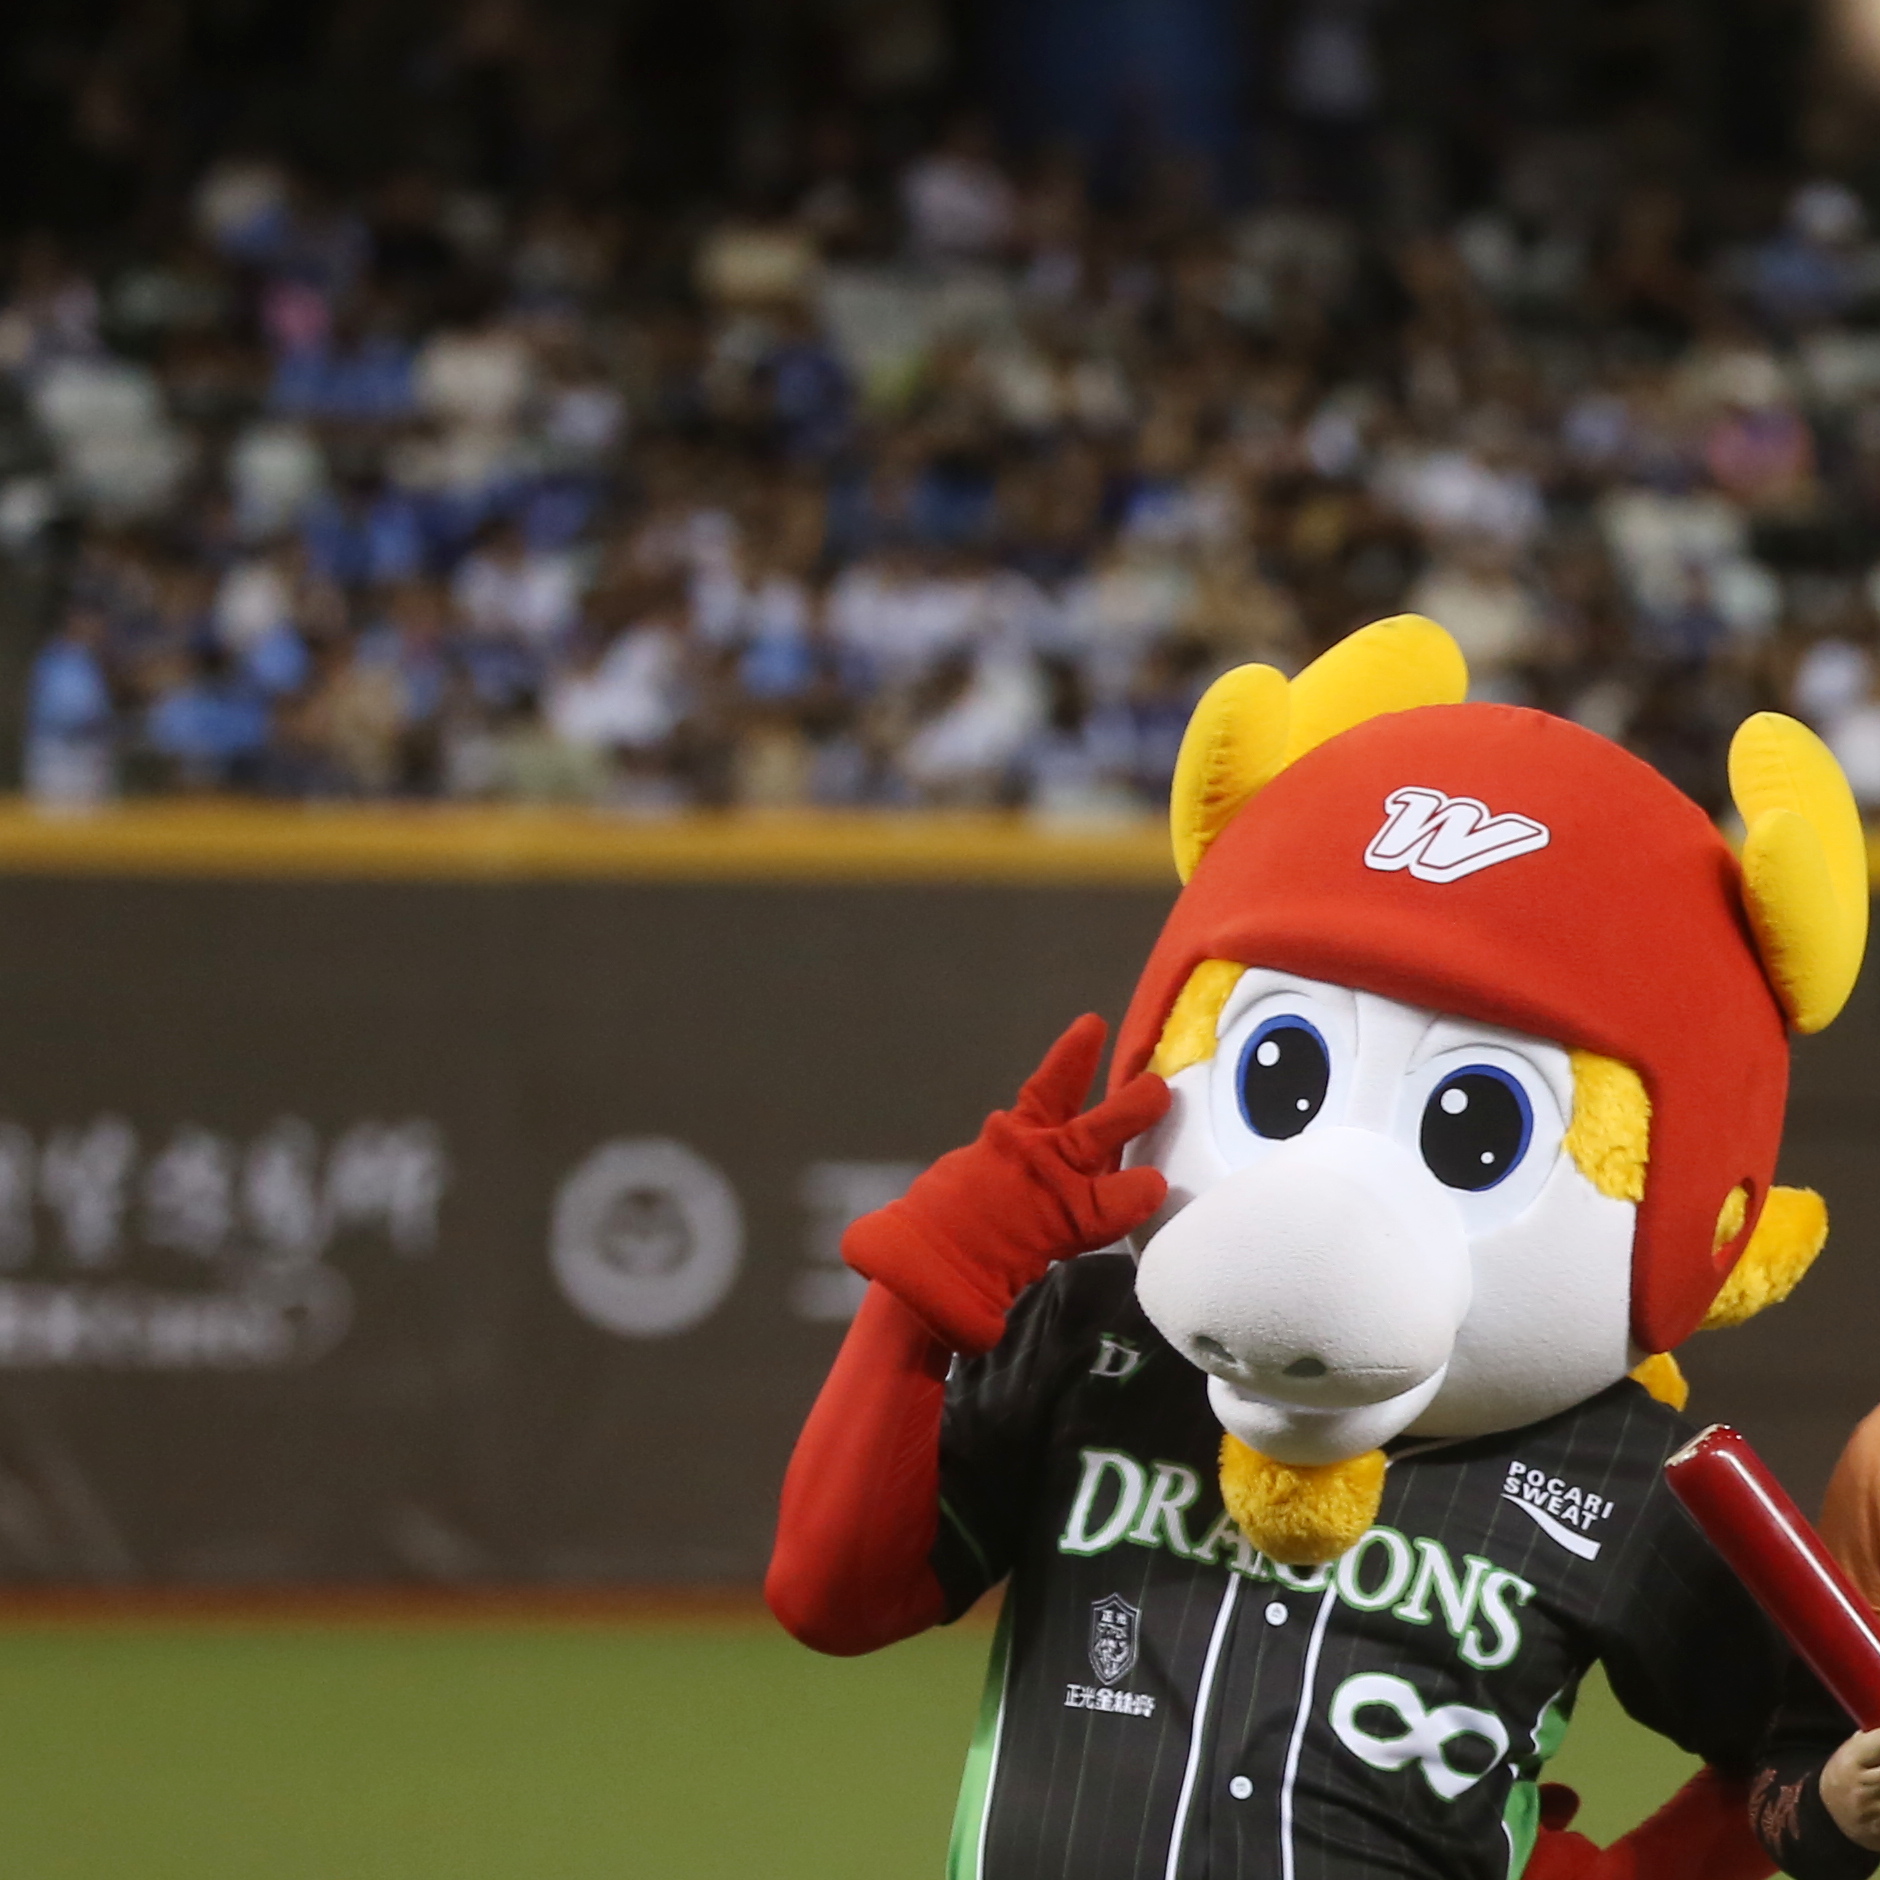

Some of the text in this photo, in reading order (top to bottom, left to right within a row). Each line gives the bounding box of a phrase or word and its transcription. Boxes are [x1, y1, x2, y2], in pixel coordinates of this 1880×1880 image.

[1364, 786, 1550, 884] W
[1503, 1476, 1599, 1531] SWEAT
[1508, 1460, 1615, 1519] POCARI
[1058, 1447, 1537, 1671] DRAONS
